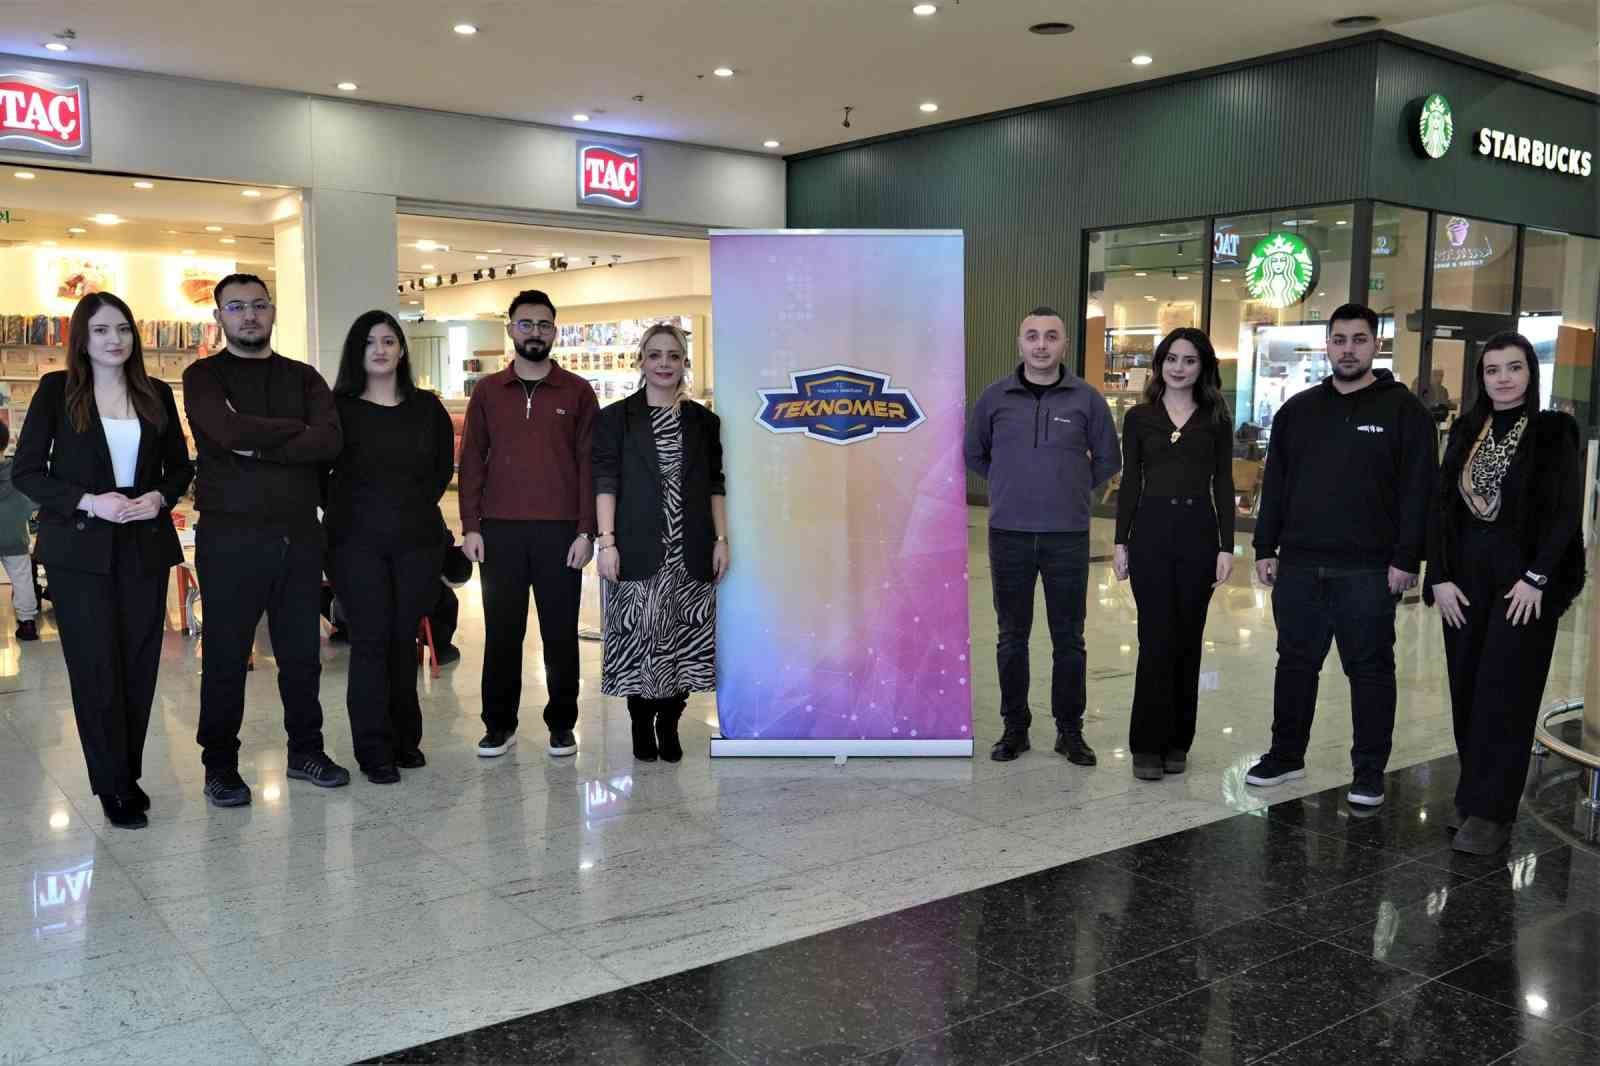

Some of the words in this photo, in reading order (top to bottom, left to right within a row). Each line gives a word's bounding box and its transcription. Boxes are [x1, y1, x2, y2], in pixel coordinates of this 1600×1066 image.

[0, 88, 77, 140] TAÇ
[1478, 127, 1593, 177] STARBUCKS
[585, 157, 637, 197] TAÇ
[772, 398, 908, 420] TEKNOMER
